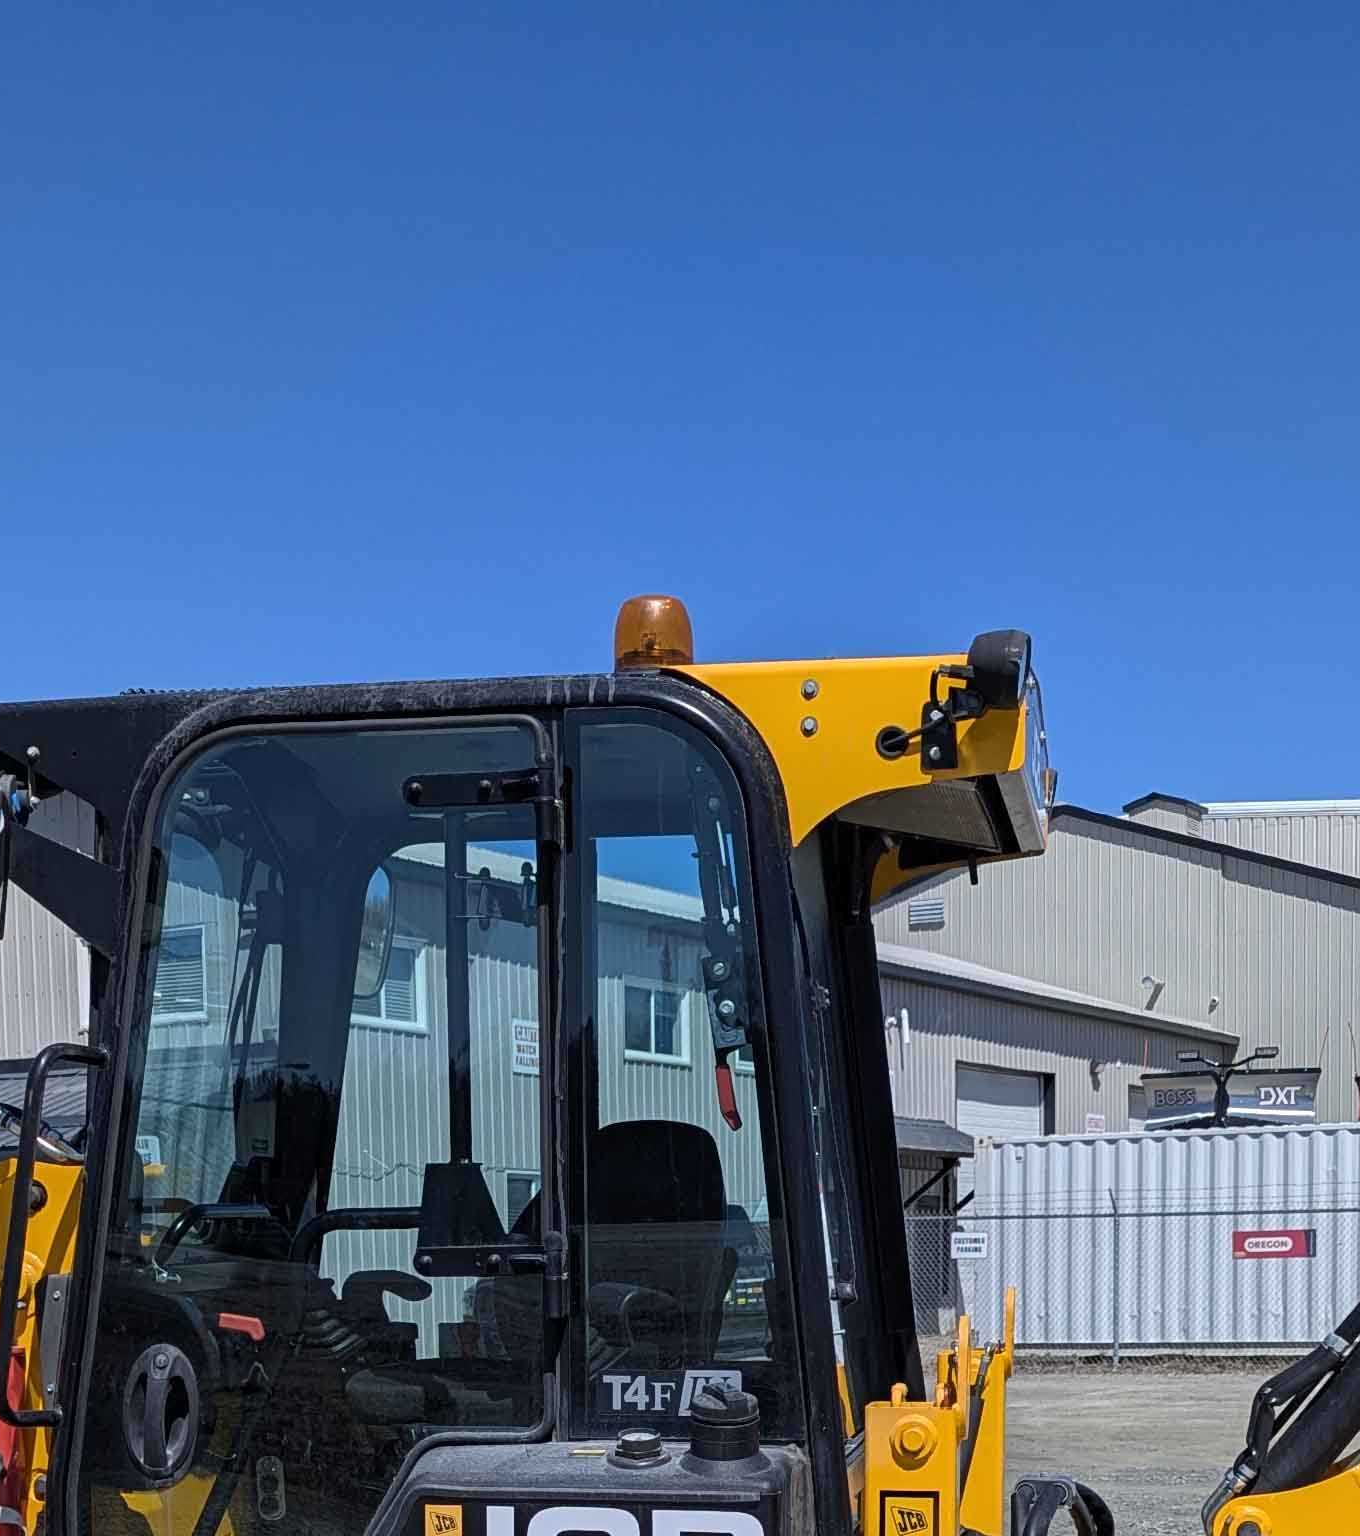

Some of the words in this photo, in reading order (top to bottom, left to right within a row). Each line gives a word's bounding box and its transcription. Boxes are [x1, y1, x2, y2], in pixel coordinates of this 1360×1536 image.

[1155, 1088, 1196, 1105] BOSS
[1259, 1087, 1301, 1105] DXT
[1247, 1240, 1288, 1249] OREGON
[435, 1513, 457, 1533] JCB
[897, 1510, 925, 1532] JCB
